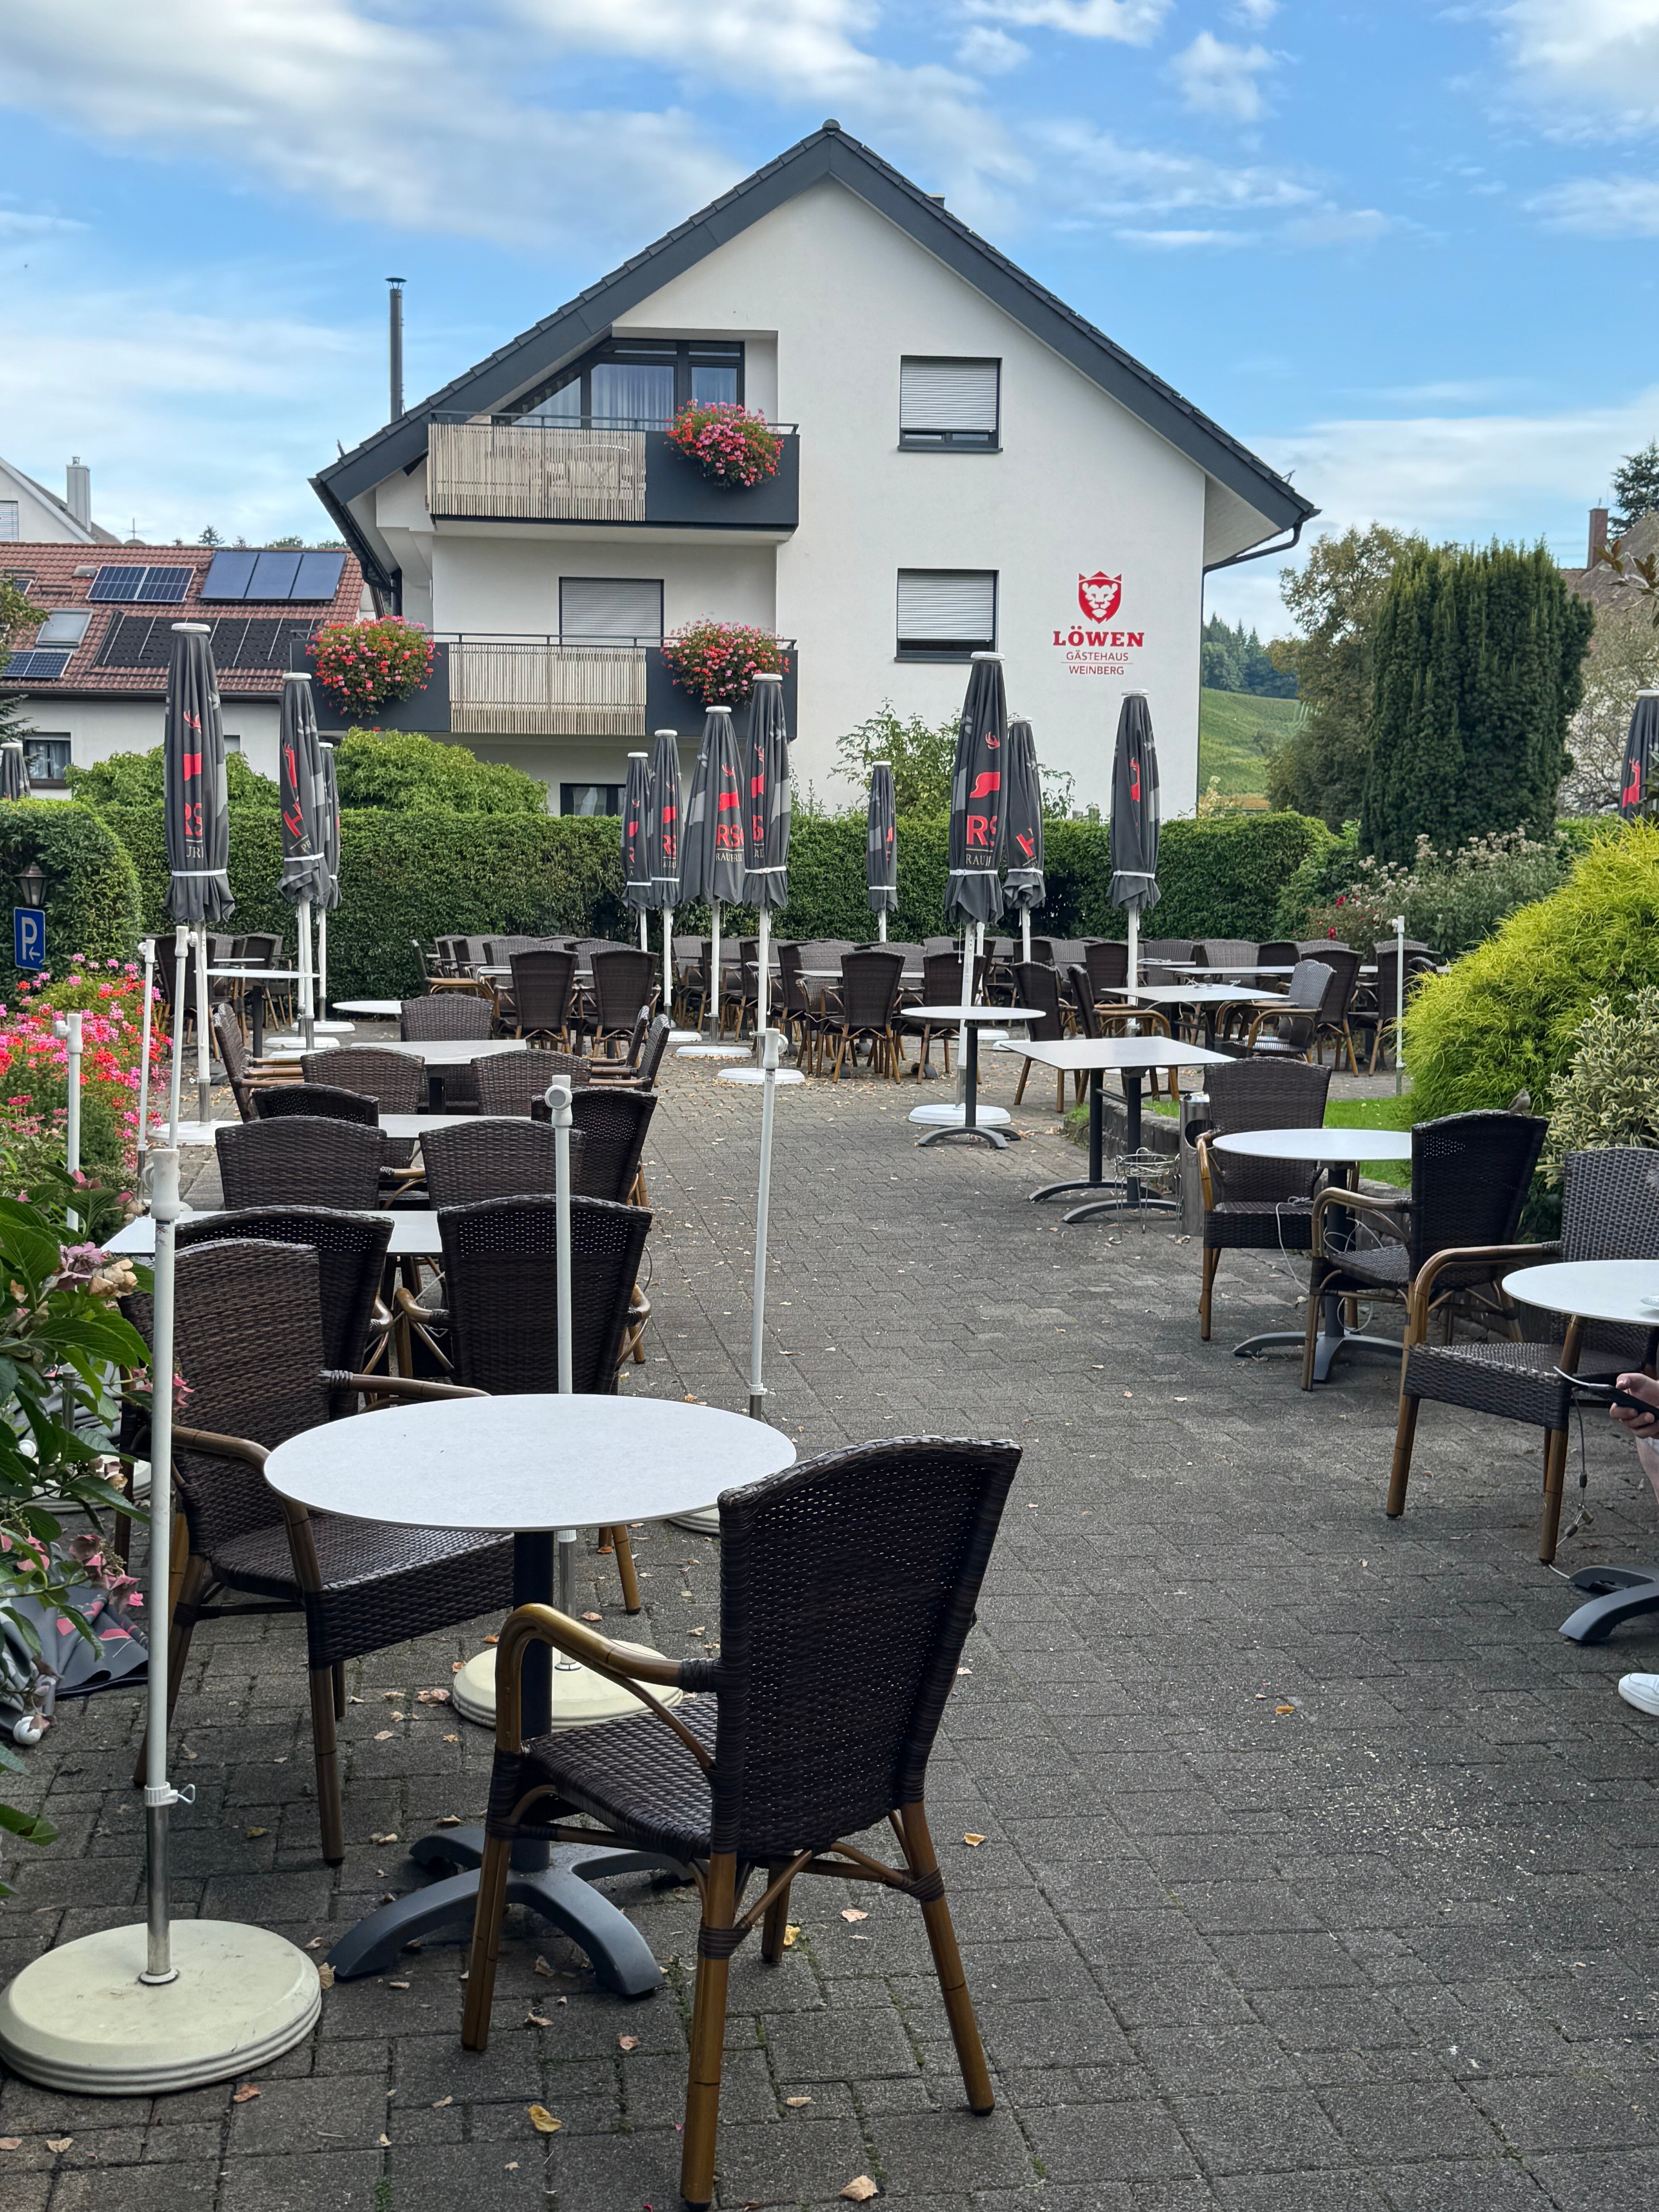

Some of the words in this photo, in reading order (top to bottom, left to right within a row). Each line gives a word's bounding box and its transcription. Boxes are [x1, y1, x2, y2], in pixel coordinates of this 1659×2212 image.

[1053, 625, 1144, 647] LÖWEN
[1066, 650, 1128, 661] GÄSTEHAUS
[1069, 665, 1124, 675] WEINBERG
[22, 917, 37, 960] P
